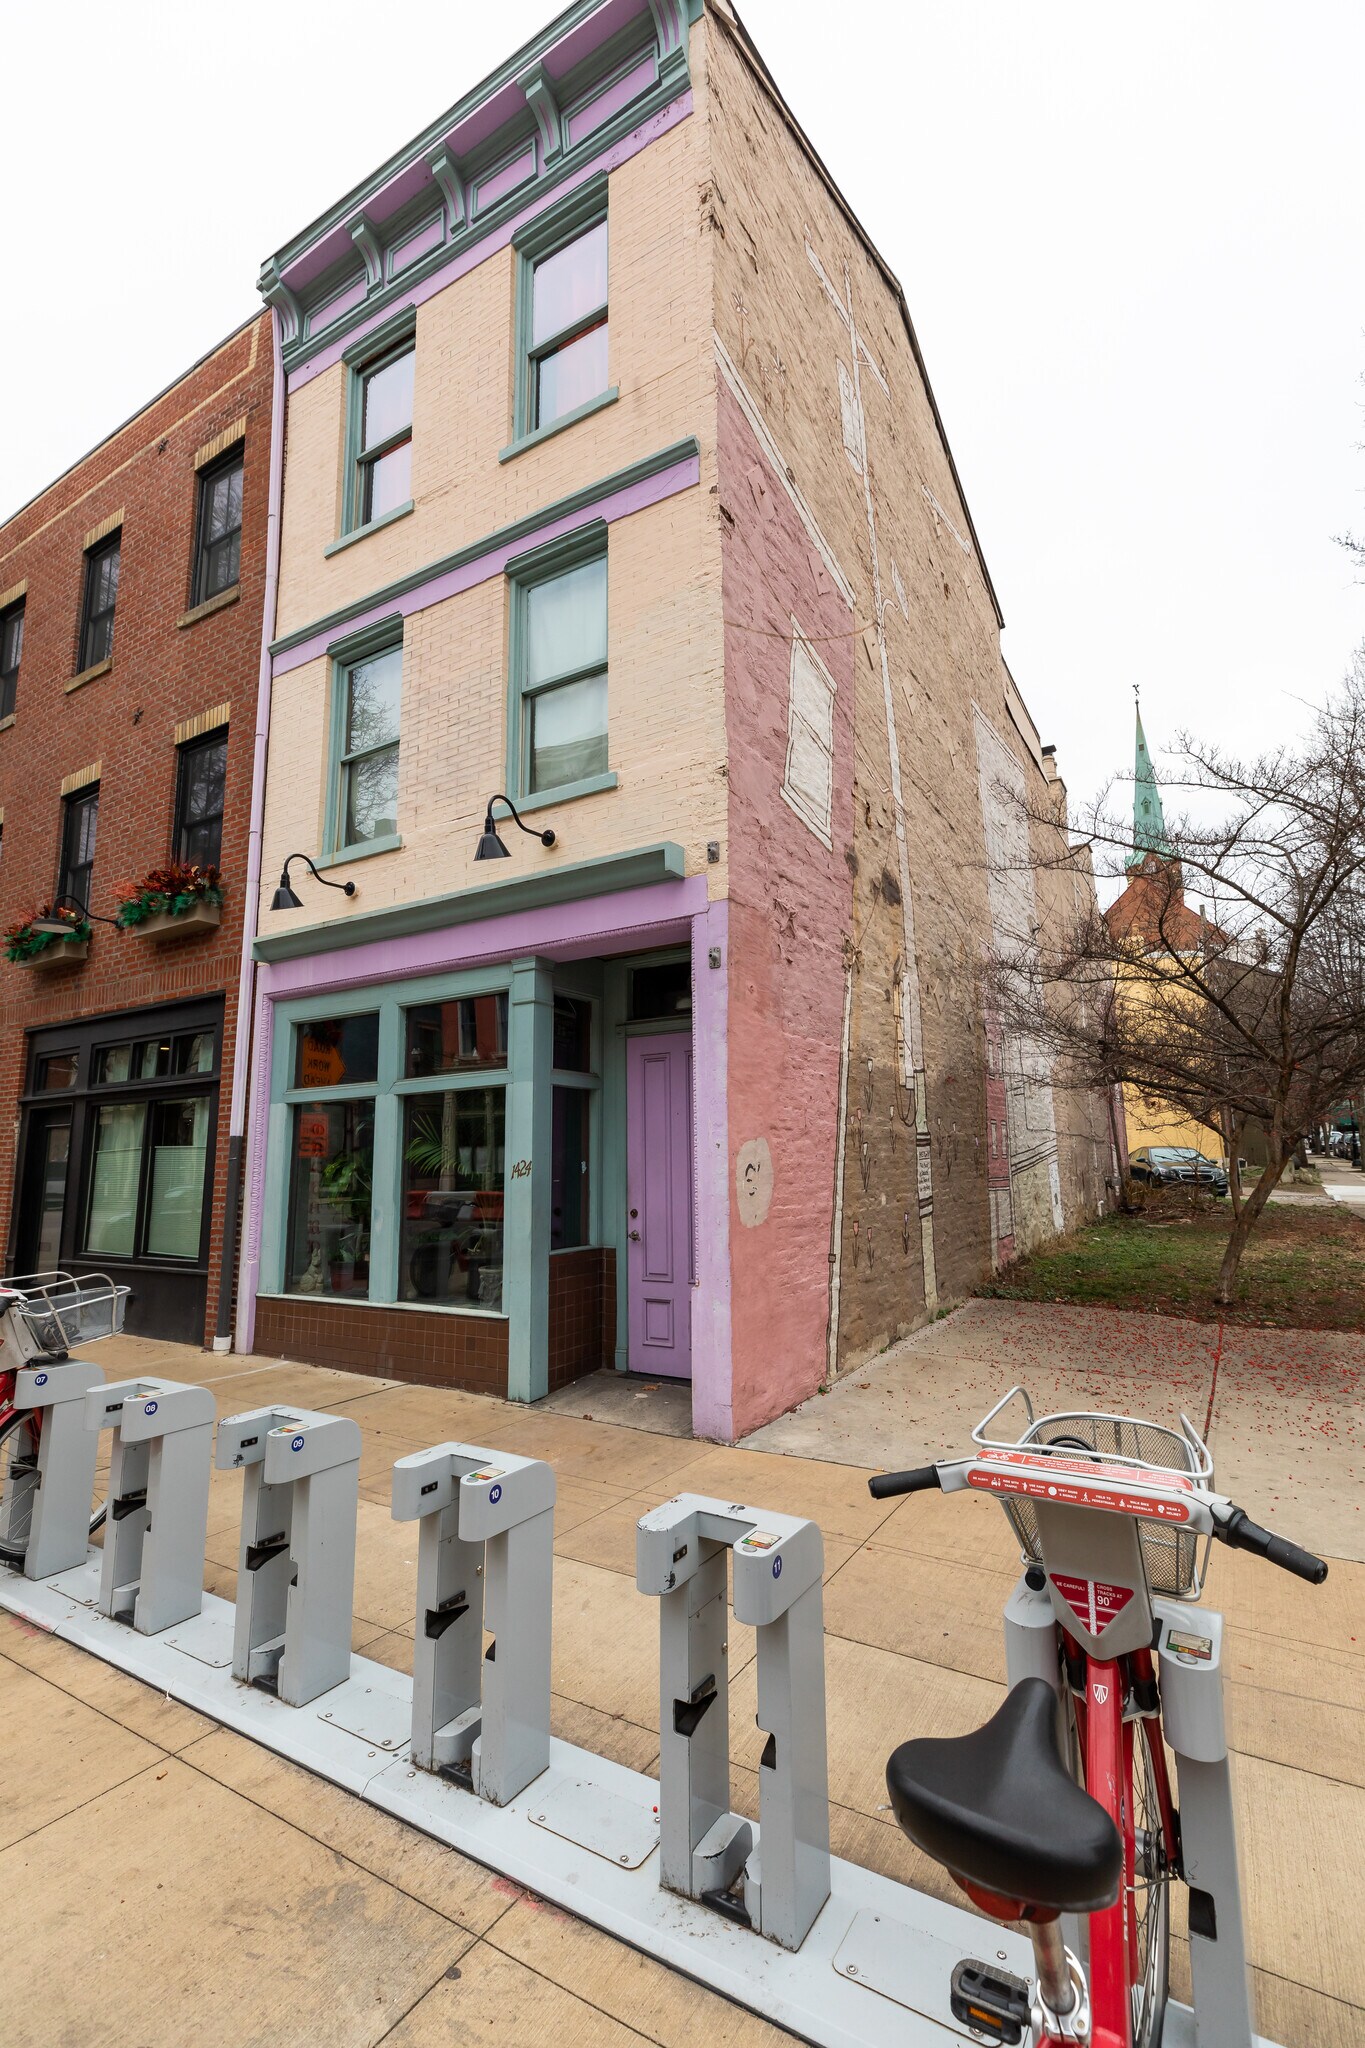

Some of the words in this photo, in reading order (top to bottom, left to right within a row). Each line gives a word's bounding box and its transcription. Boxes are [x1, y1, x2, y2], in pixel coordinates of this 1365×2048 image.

[511, 1159, 532, 1181] 1424
[36, 1376, 46, 1384] 07
[145, 1404, 156, 1413] 08
[293, 1439, 303, 1448] 09
[491, 1489, 500, 1500] 10
[774, 1560, 781, 1573] 11
[1063, 1582, 1086, 1591] CAREFUL!
[1097, 1590, 1116, 1598] TRACKS
